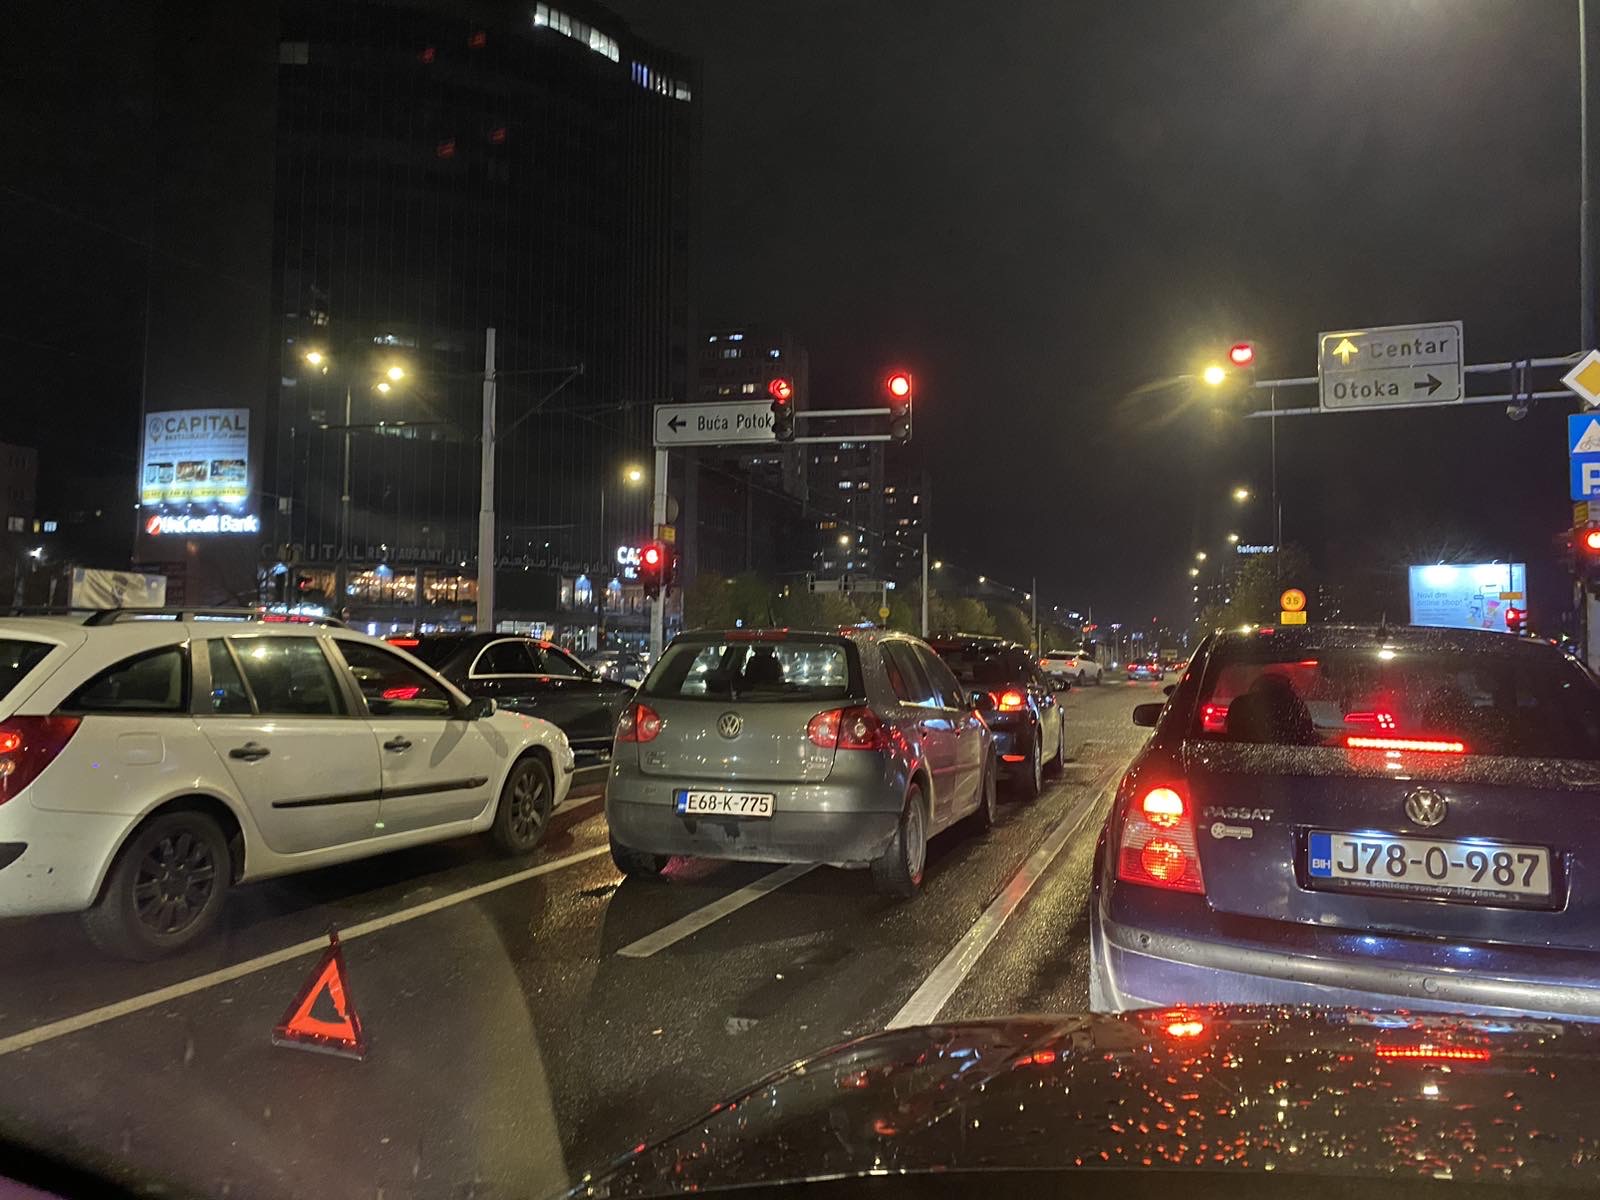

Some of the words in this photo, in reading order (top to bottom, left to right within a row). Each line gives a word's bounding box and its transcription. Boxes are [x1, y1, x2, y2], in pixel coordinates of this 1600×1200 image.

[1370, 338, 1449, 359] Centar
[1333, 380, 1399, 399] Otoka
[164, 415, 247, 433] CAPITAL
[697, 413, 729, 431] Buća
[736, 413, 773, 429] Potok
[688, 794, 770, 814] E68-K-775
[1202, 805, 1275, 821] PASSAT
[1312, 858, 1332, 870] BIH
